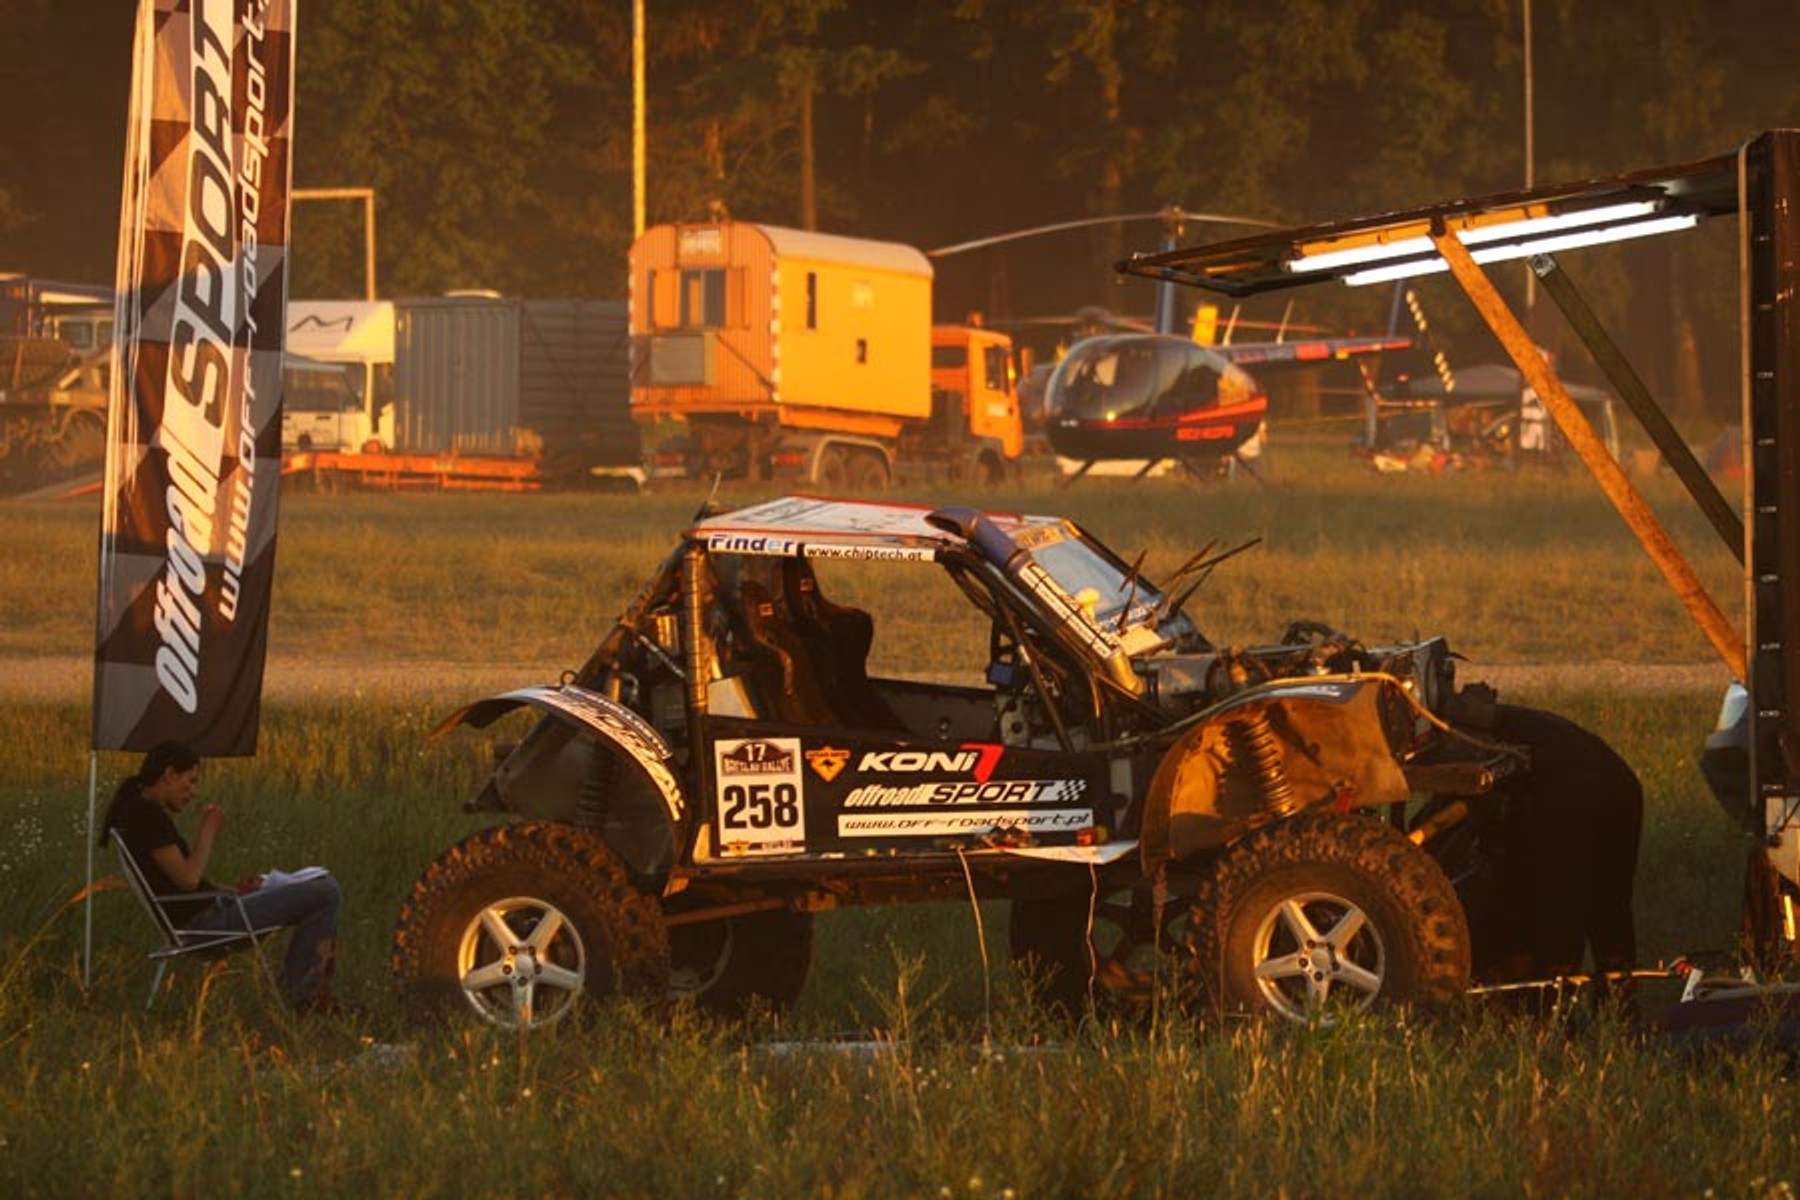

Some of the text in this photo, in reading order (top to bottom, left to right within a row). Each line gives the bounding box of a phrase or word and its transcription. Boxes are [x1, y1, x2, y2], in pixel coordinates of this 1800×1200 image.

[155, 0, 233, 714] offroad SPORT
[710, 534, 793, 553] Finder
[805, 547, 922, 561] www.chiptech.at
[745, 743, 766, 761] 17
[844, 781, 1056, 807] offroad SPORT
[724, 783, 799, 828] 258
